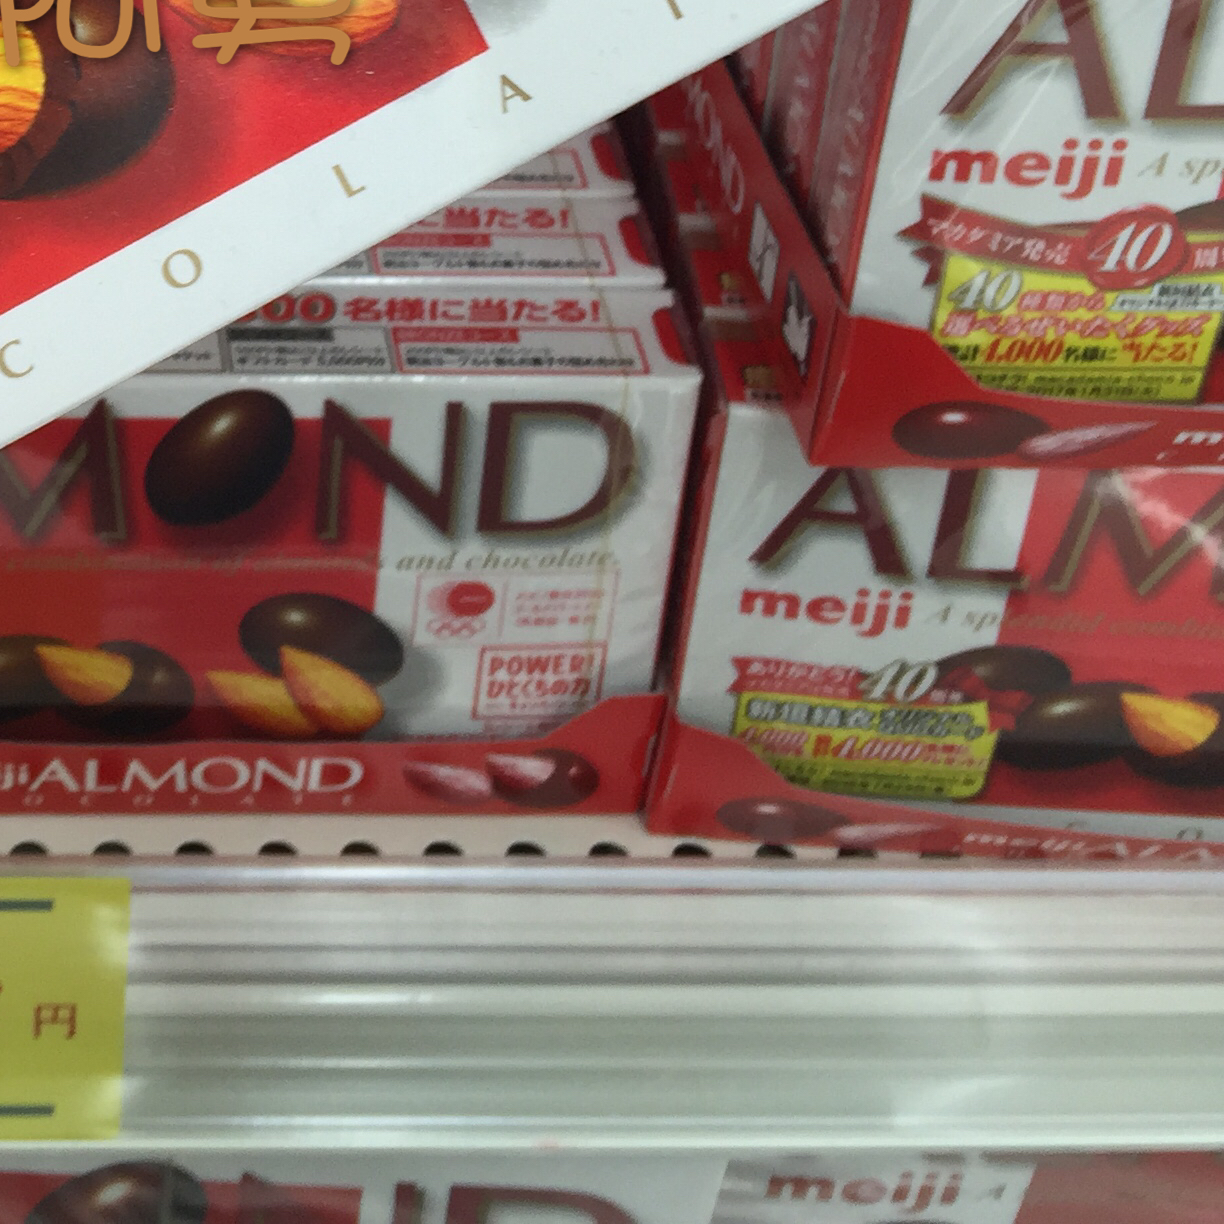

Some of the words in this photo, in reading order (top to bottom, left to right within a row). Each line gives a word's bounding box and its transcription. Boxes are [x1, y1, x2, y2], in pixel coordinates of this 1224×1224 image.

[927, 137, 1129, 201] meiji
[1087, 221, 1175, 274] 40
[238, 289, 601, 324] 00名様に当たる!
[738, 587, 915, 638] meiji
[858, 658, 939, 703] 40
[28, 755, 365, 794] ALMOND
[33, 1002, 78, 1040] 円
